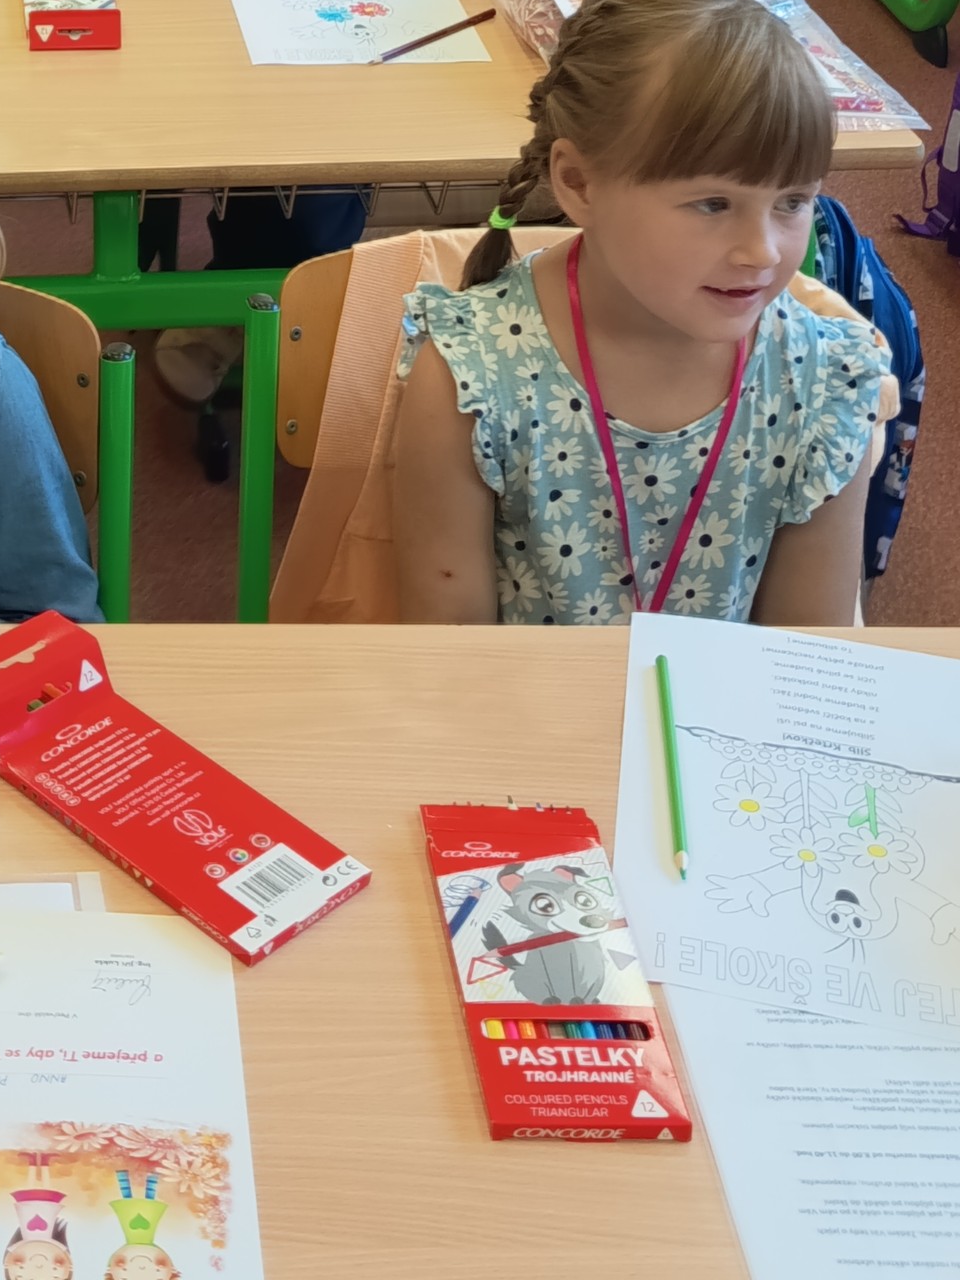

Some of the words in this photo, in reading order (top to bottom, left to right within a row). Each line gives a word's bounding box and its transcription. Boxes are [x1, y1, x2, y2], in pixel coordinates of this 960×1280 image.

[83, 670, 94, 682] 12
[41, 717, 112, 762] CONCORDE
[782, 732, 841, 751] Krtečkovi
[848, 746, 871, 756] Slib
[441, 850, 520, 859] CONCORDE
[678, 935, 811, 1005] ŠKOLE
[824, 963, 881, 1012] VE
[5, 1049, 20, 1058] se
[26, 1046, 54, 1060] aby
[58, 1049, 78, 1061] Ti,
[82, 1049, 147, 1063] přejeme
[154, 1053, 162, 1062] a
[498, 1046, 645, 1068] PASTELKY
[523, 1069, 635, 1083] TROJHRANNÉ
[504, 1094, 573, 1106] COLOURED
[575, 1094, 629, 1106] PENCILS
[530, 1107, 609, 1118] TRIANGULAR
[640, 1101, 656, 1113] 12
[513, 1127, 627, 1139] CONCORDE
